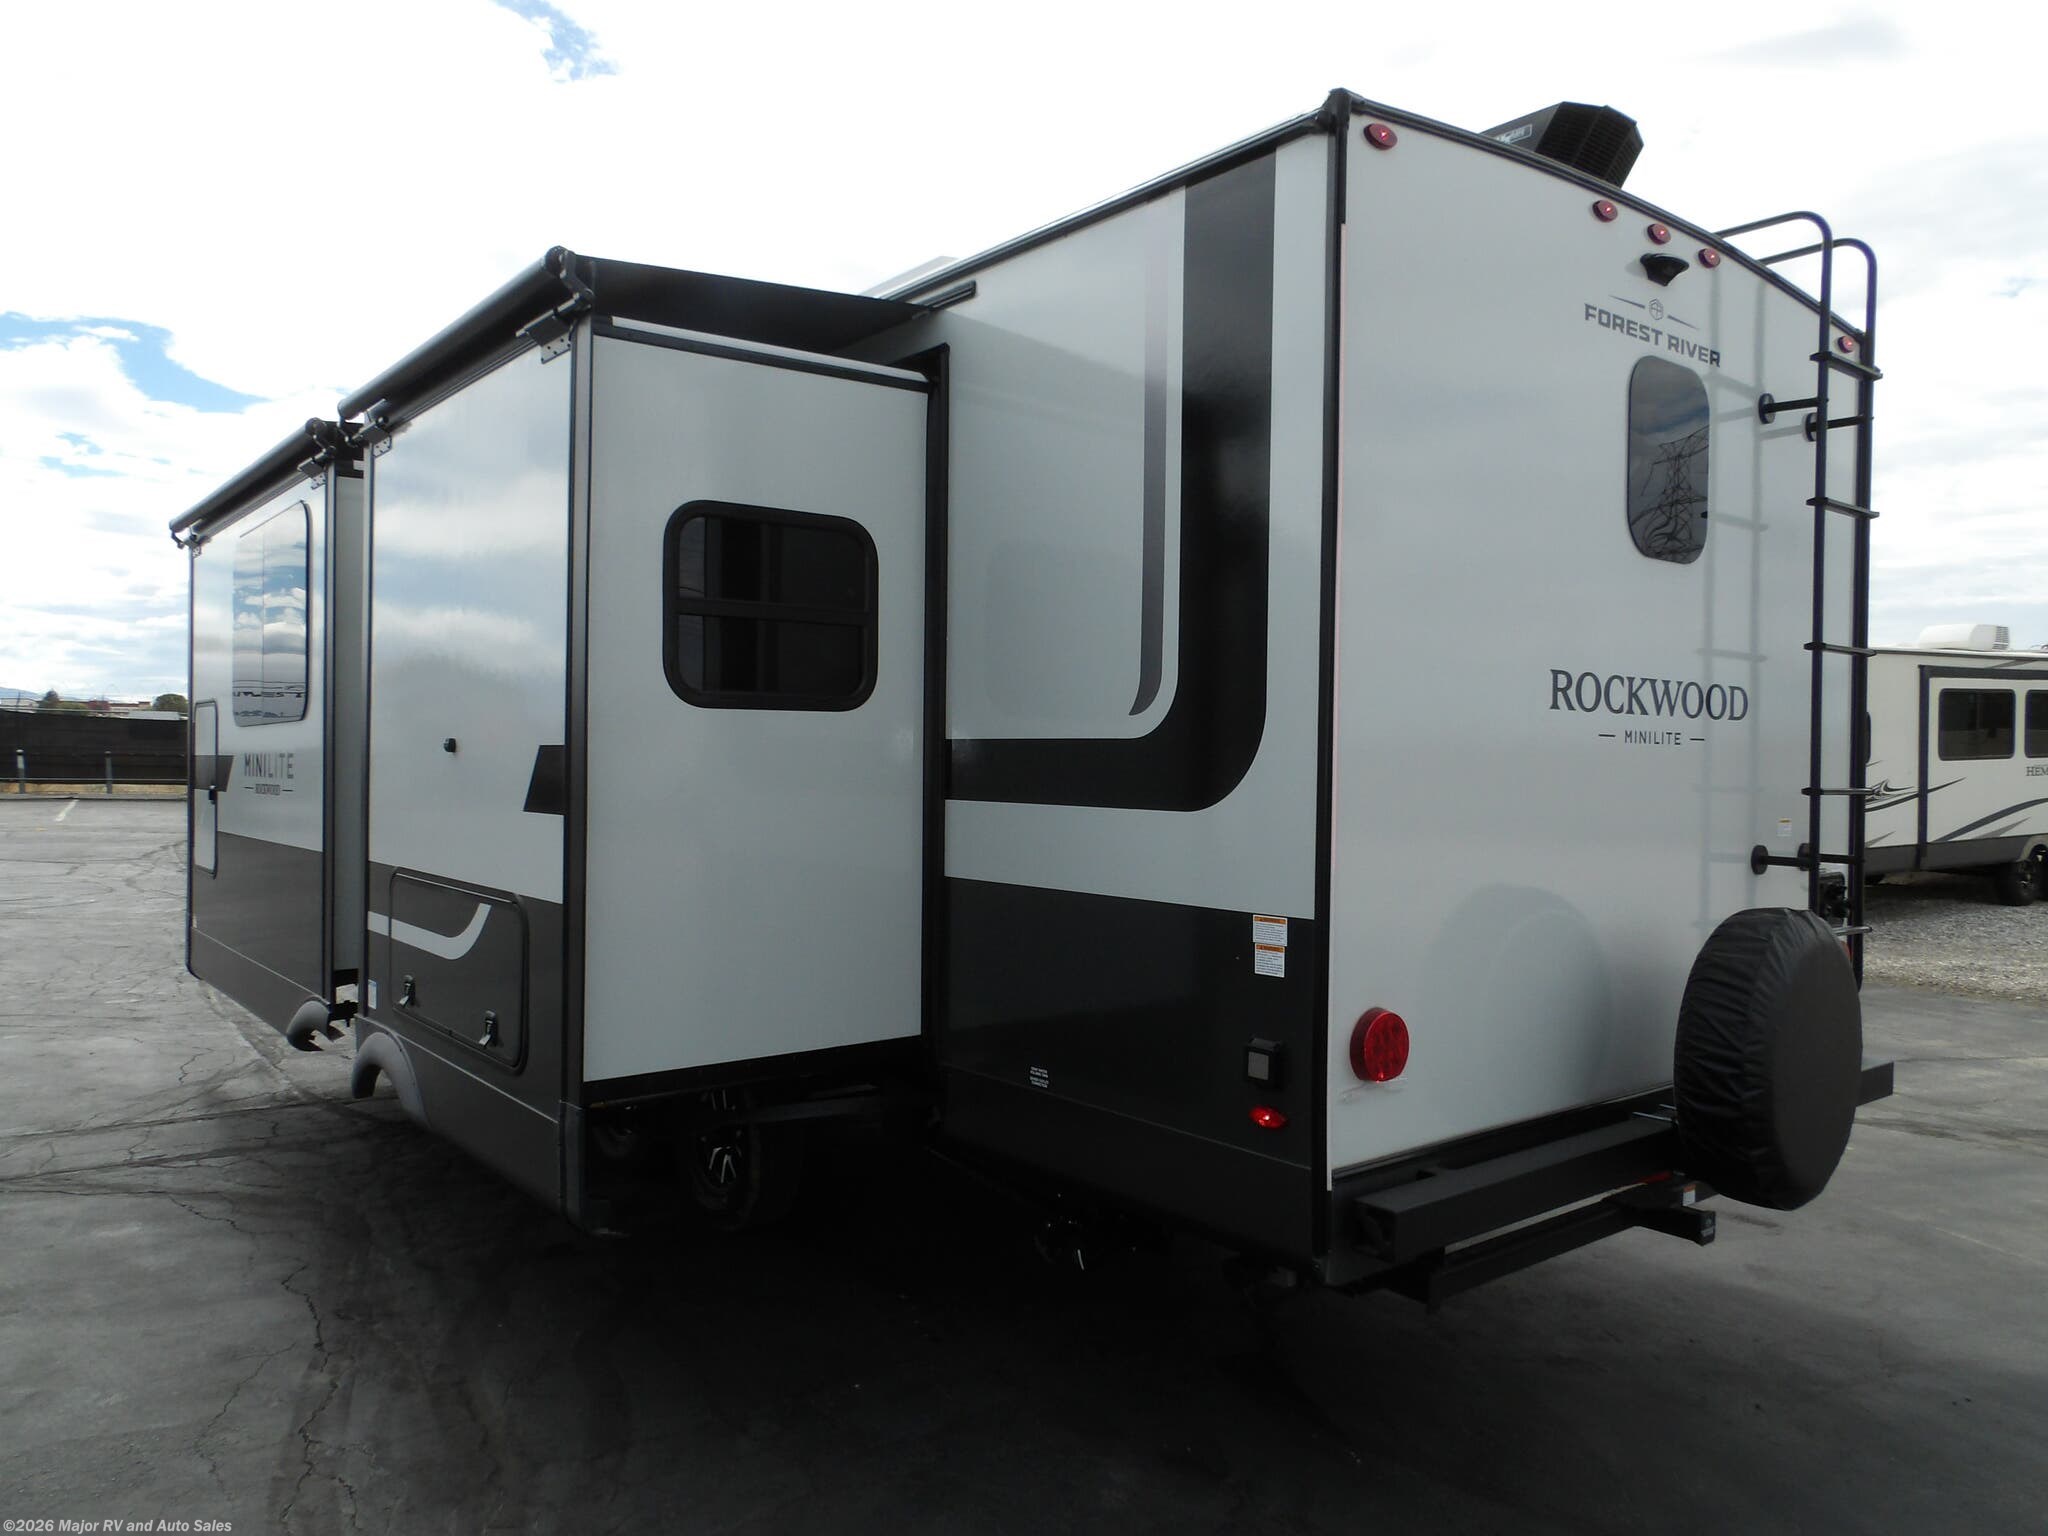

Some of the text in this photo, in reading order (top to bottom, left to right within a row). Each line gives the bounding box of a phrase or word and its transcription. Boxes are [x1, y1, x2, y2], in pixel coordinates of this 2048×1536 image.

[1584, 303, 1721, 368] FOREST RIVER
[1549, 668, 1749, 721] ROCKWOOD
[1624, 730, 1682, 746] MINILITE
[244, 752, 294, 779] MINILITE
